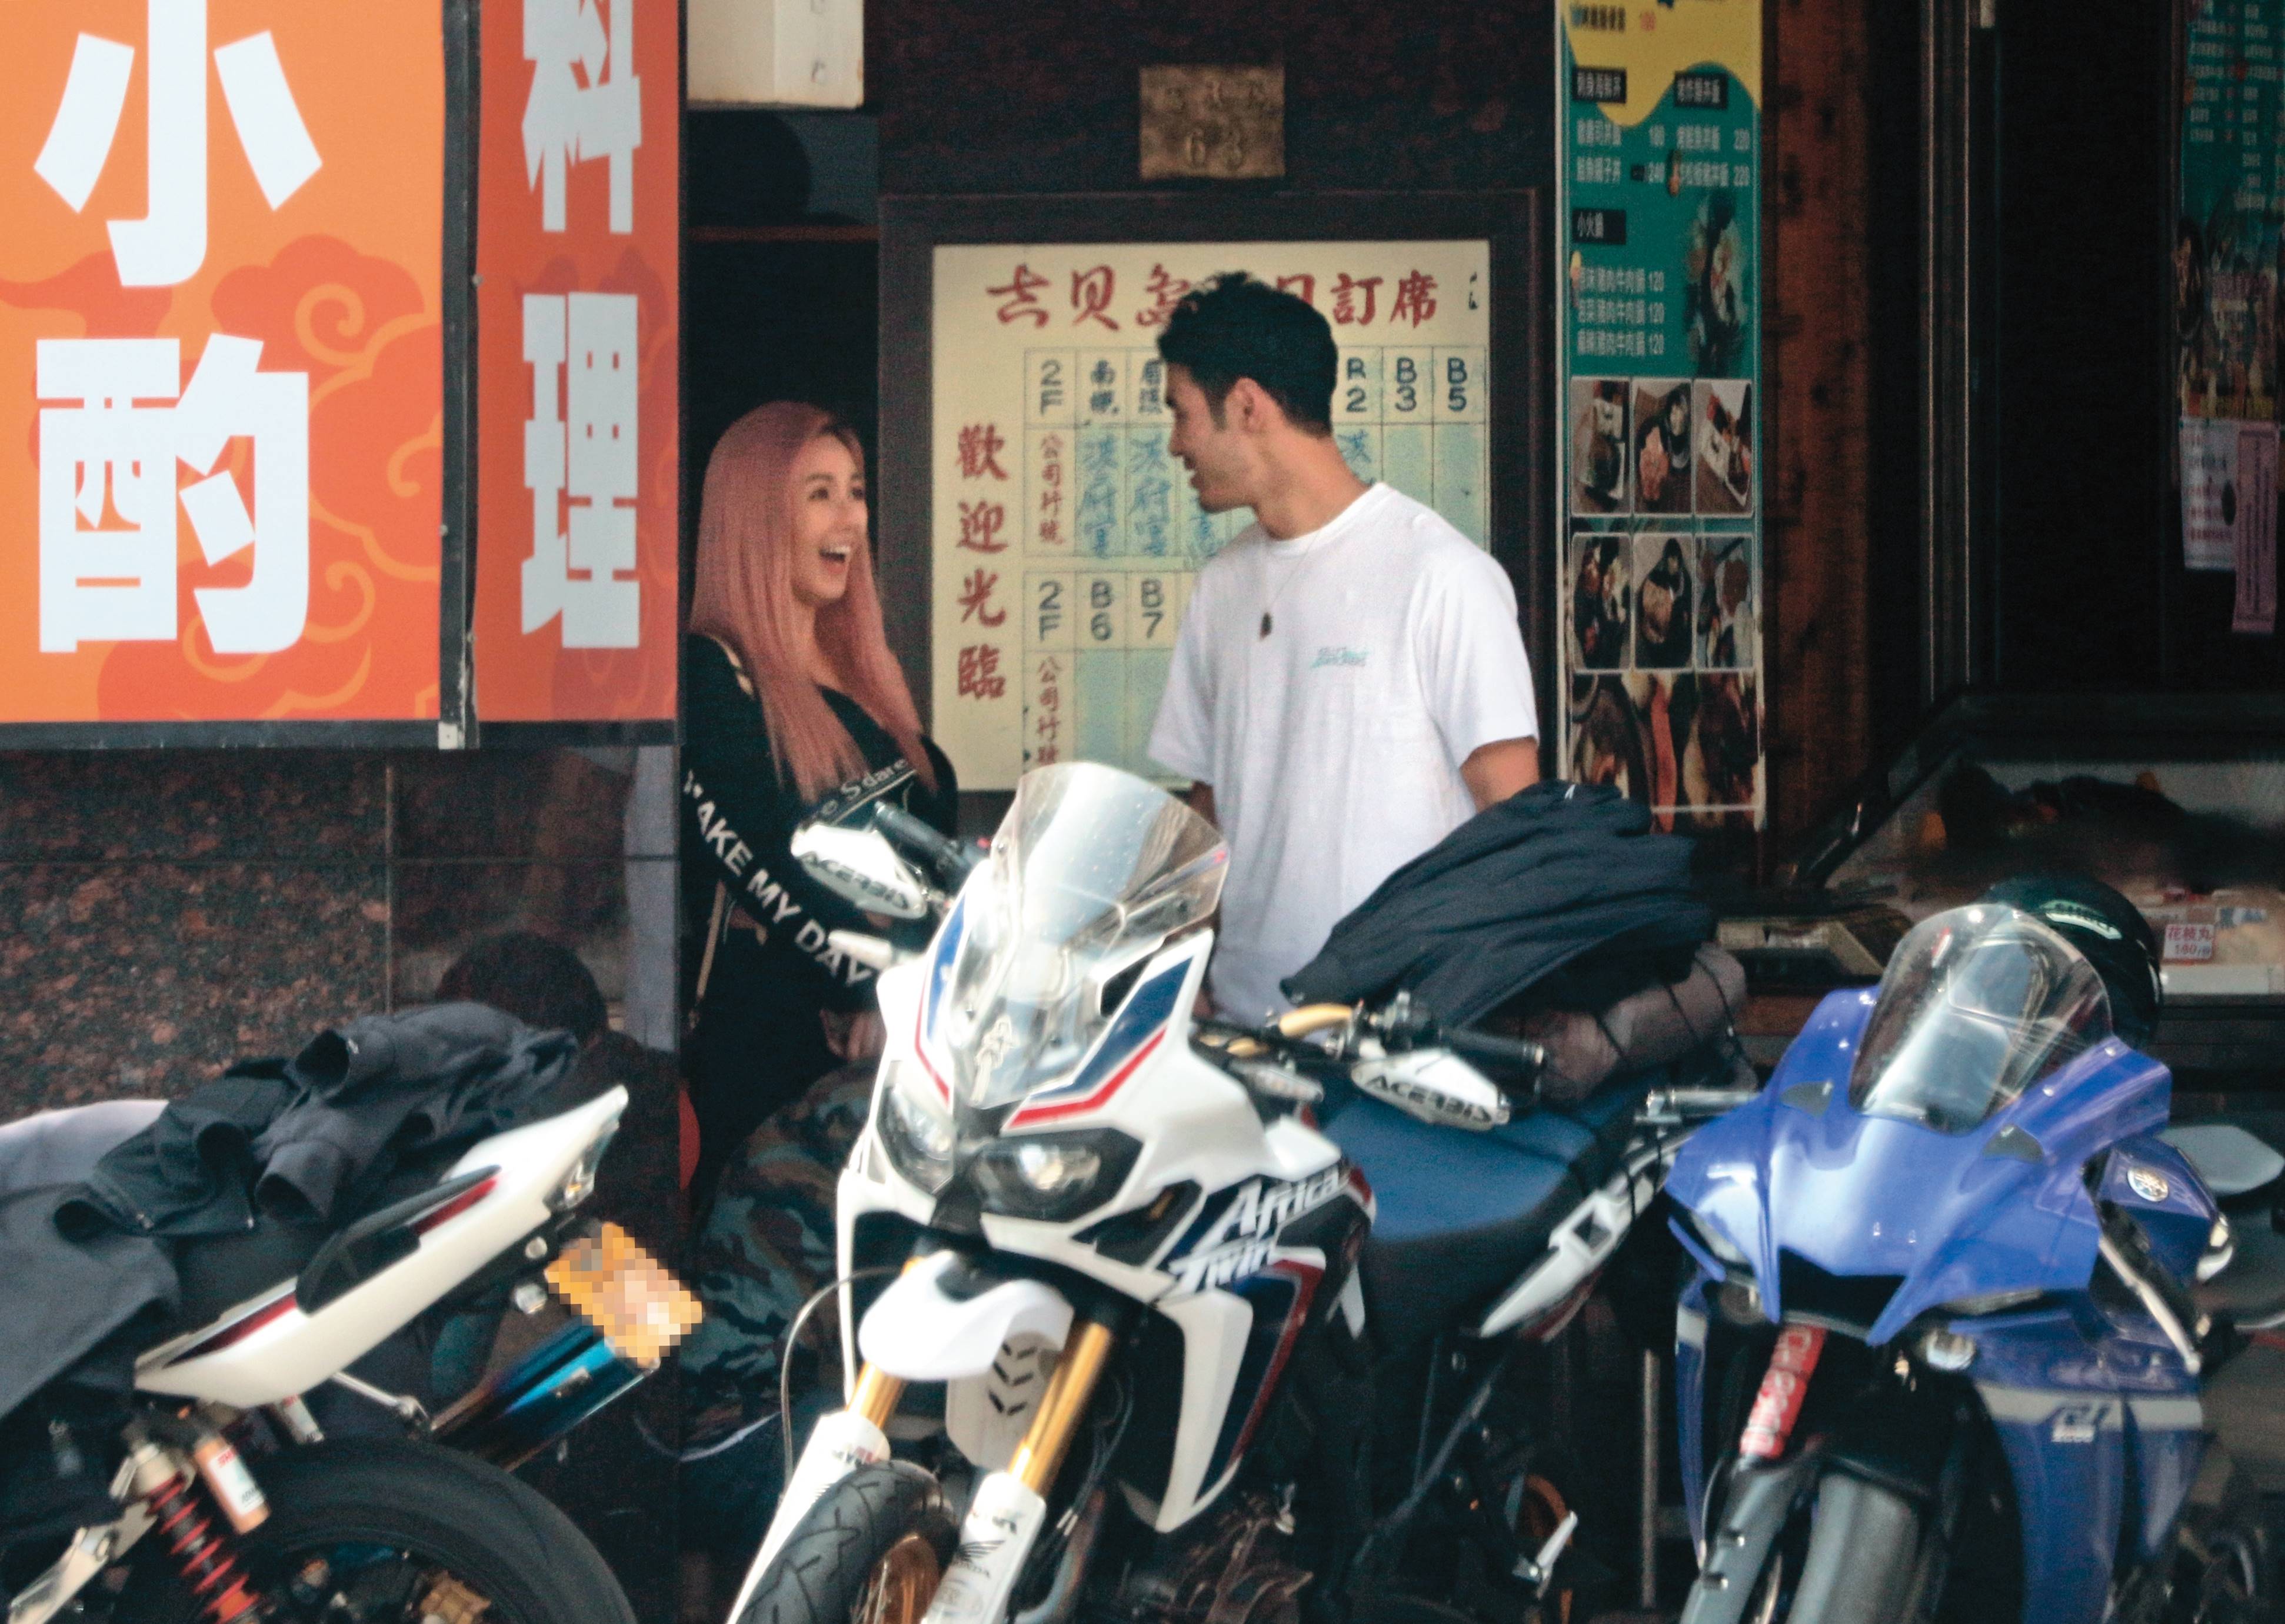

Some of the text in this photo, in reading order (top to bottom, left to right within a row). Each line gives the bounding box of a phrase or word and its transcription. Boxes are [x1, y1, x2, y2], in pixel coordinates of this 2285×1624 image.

[34, 0, 323, 654] 小酌
[521, 0, 642, 648] 料理
[1395, 356, 1417, 412] B3
[1447, 356, 1468, 412] B5
[956, 423, 1010, 701] 歡迎光臨
[1038, 580, 1062, 642] 2F
[1090, 579, 1114, 641] B6
[1140, 577, 1165, 639] B7
[746, 868, 802, 925] MY
[1191, 1165, 1340, 1258] Africa
[1168, 1237, 1273, 1295] Twin
